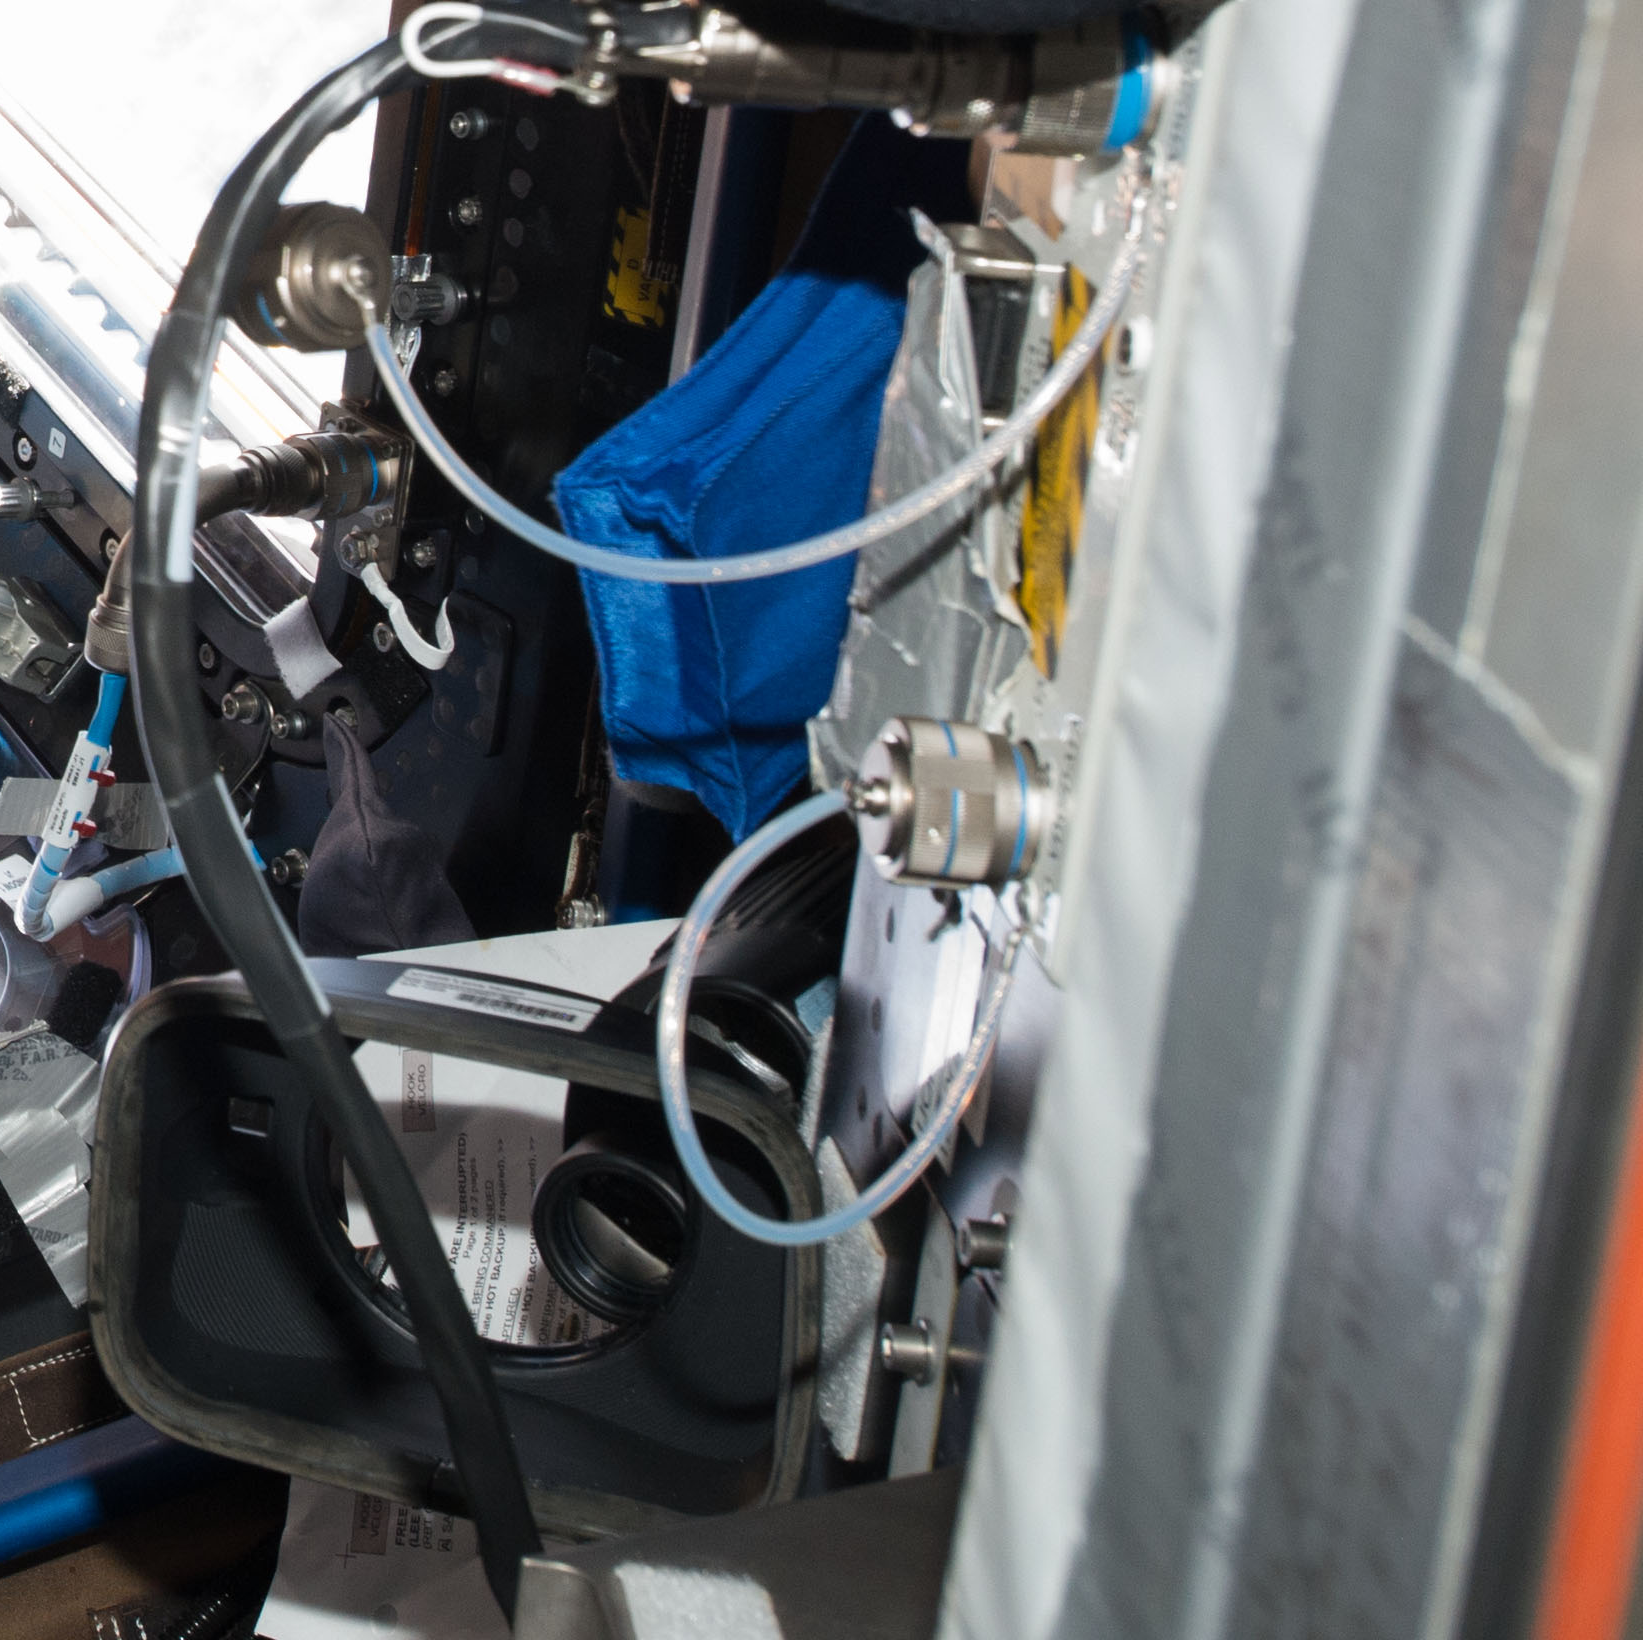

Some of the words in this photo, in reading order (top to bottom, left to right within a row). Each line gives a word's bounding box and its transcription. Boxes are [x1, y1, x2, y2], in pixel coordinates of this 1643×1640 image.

[53, 436, 62, 449] 7
[406, 1072, 415, 1109] HOOK
[419, 1064, 427, 1117] VELCRO
[456, 1132, 467, 1235] INTERRUPTED)
[469, 1157, 482, 1195] pages
[469, 1205, 479, 1218] of
[450, 1236, 463, 1265] ARE
[463, 1230, 477, 1260] Page
[472, 1266, 487, 1304] BEING
[481, 1179, 494, 1265] COMMANDED
[491, 1224, 509, 1281] BACKUP,
[486, 1285, 499, 1310] HOT
[501, 1286, 520, 1344] APTURED
[521, 1285, 534, 1313] HOT
[395, 1508, 408, 1547] FREE
[409, 1515, 422, 1549] (LEE
